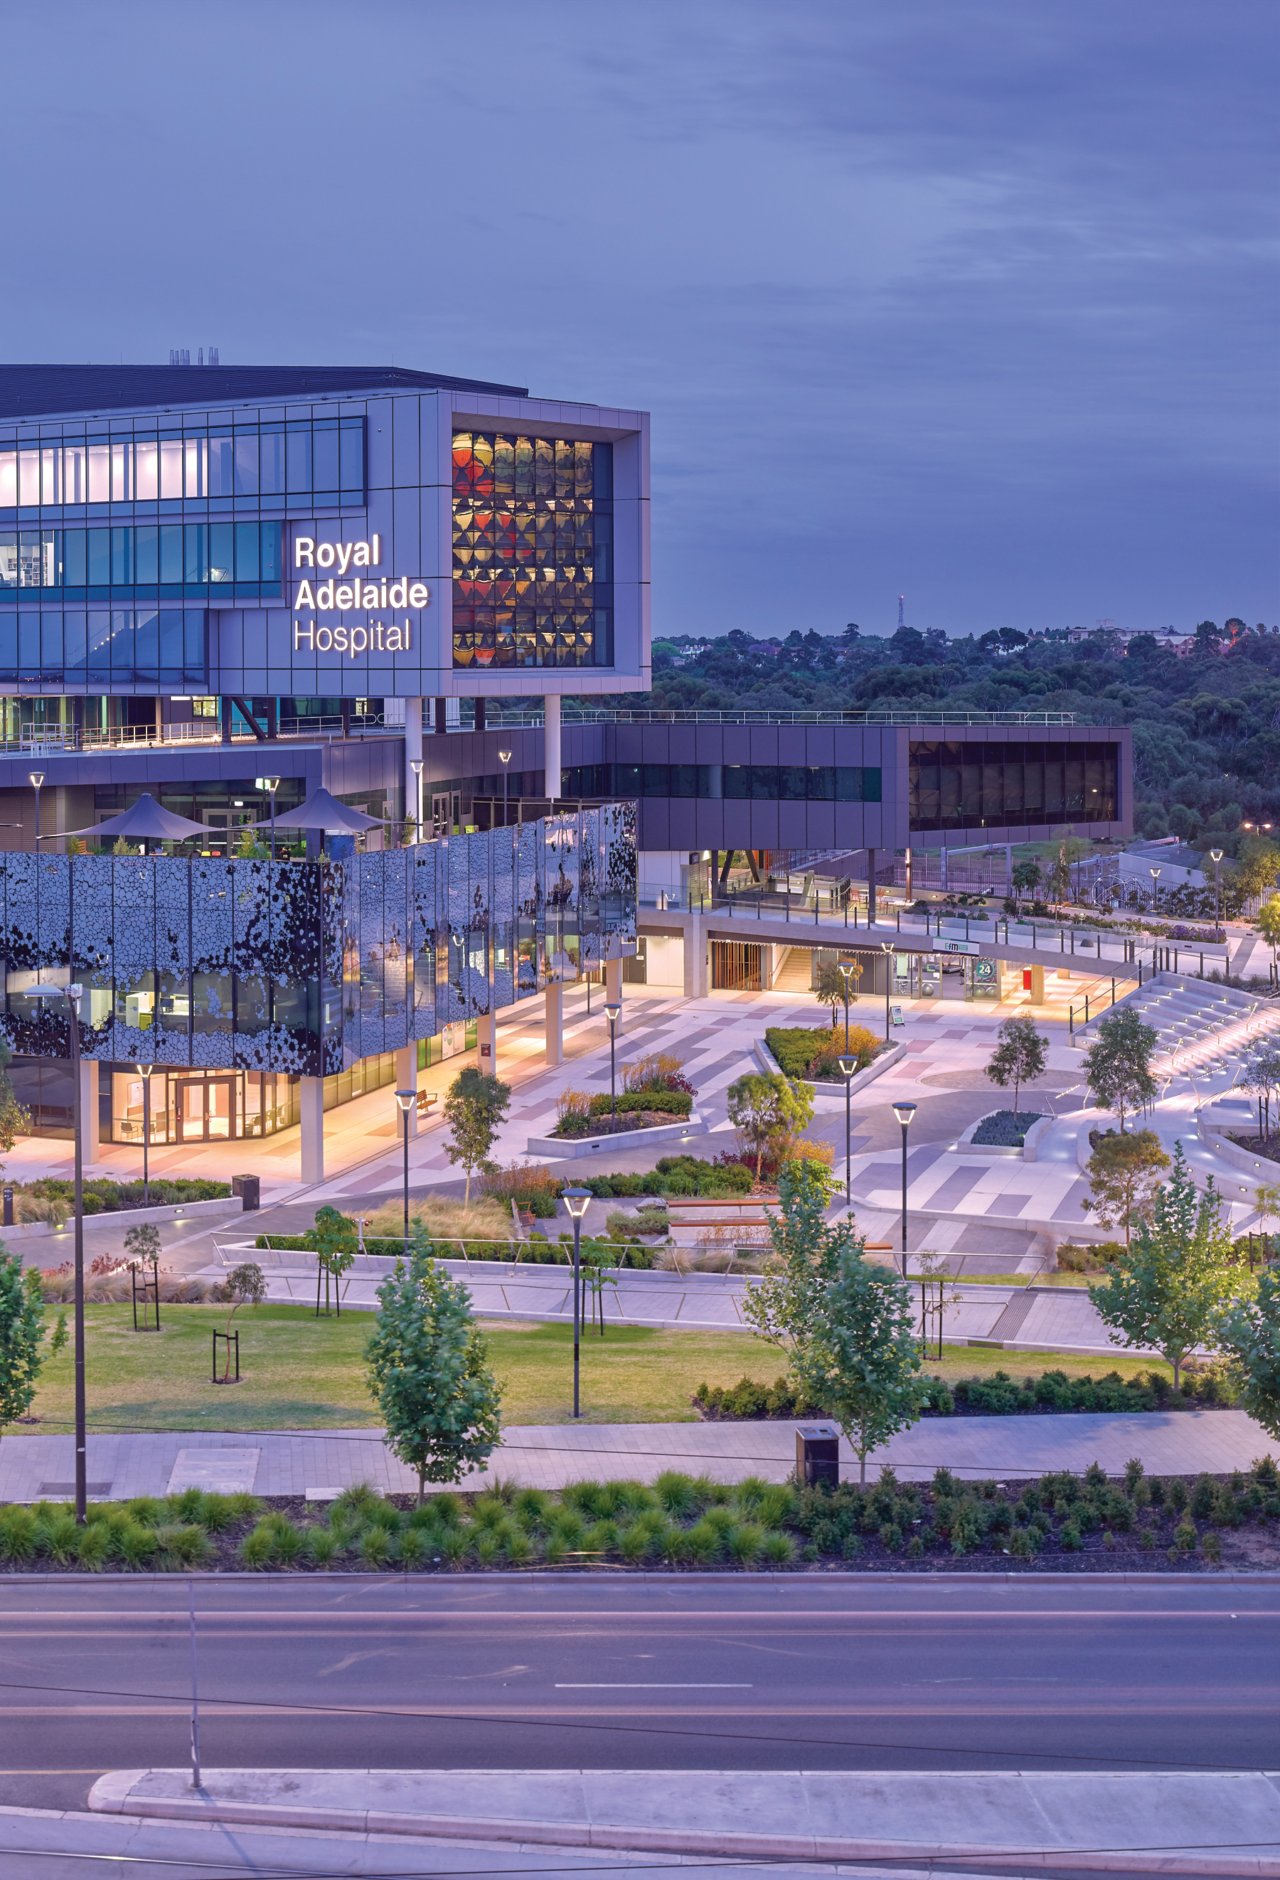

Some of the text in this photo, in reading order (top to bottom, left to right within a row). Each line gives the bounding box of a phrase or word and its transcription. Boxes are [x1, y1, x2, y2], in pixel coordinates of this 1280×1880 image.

[295, 533, 379, 575] Royal
[294, 576, 428, 610] Adelaide
[294, 618, 410, 659] Hospital
[979, 965, 991, 974] 24
